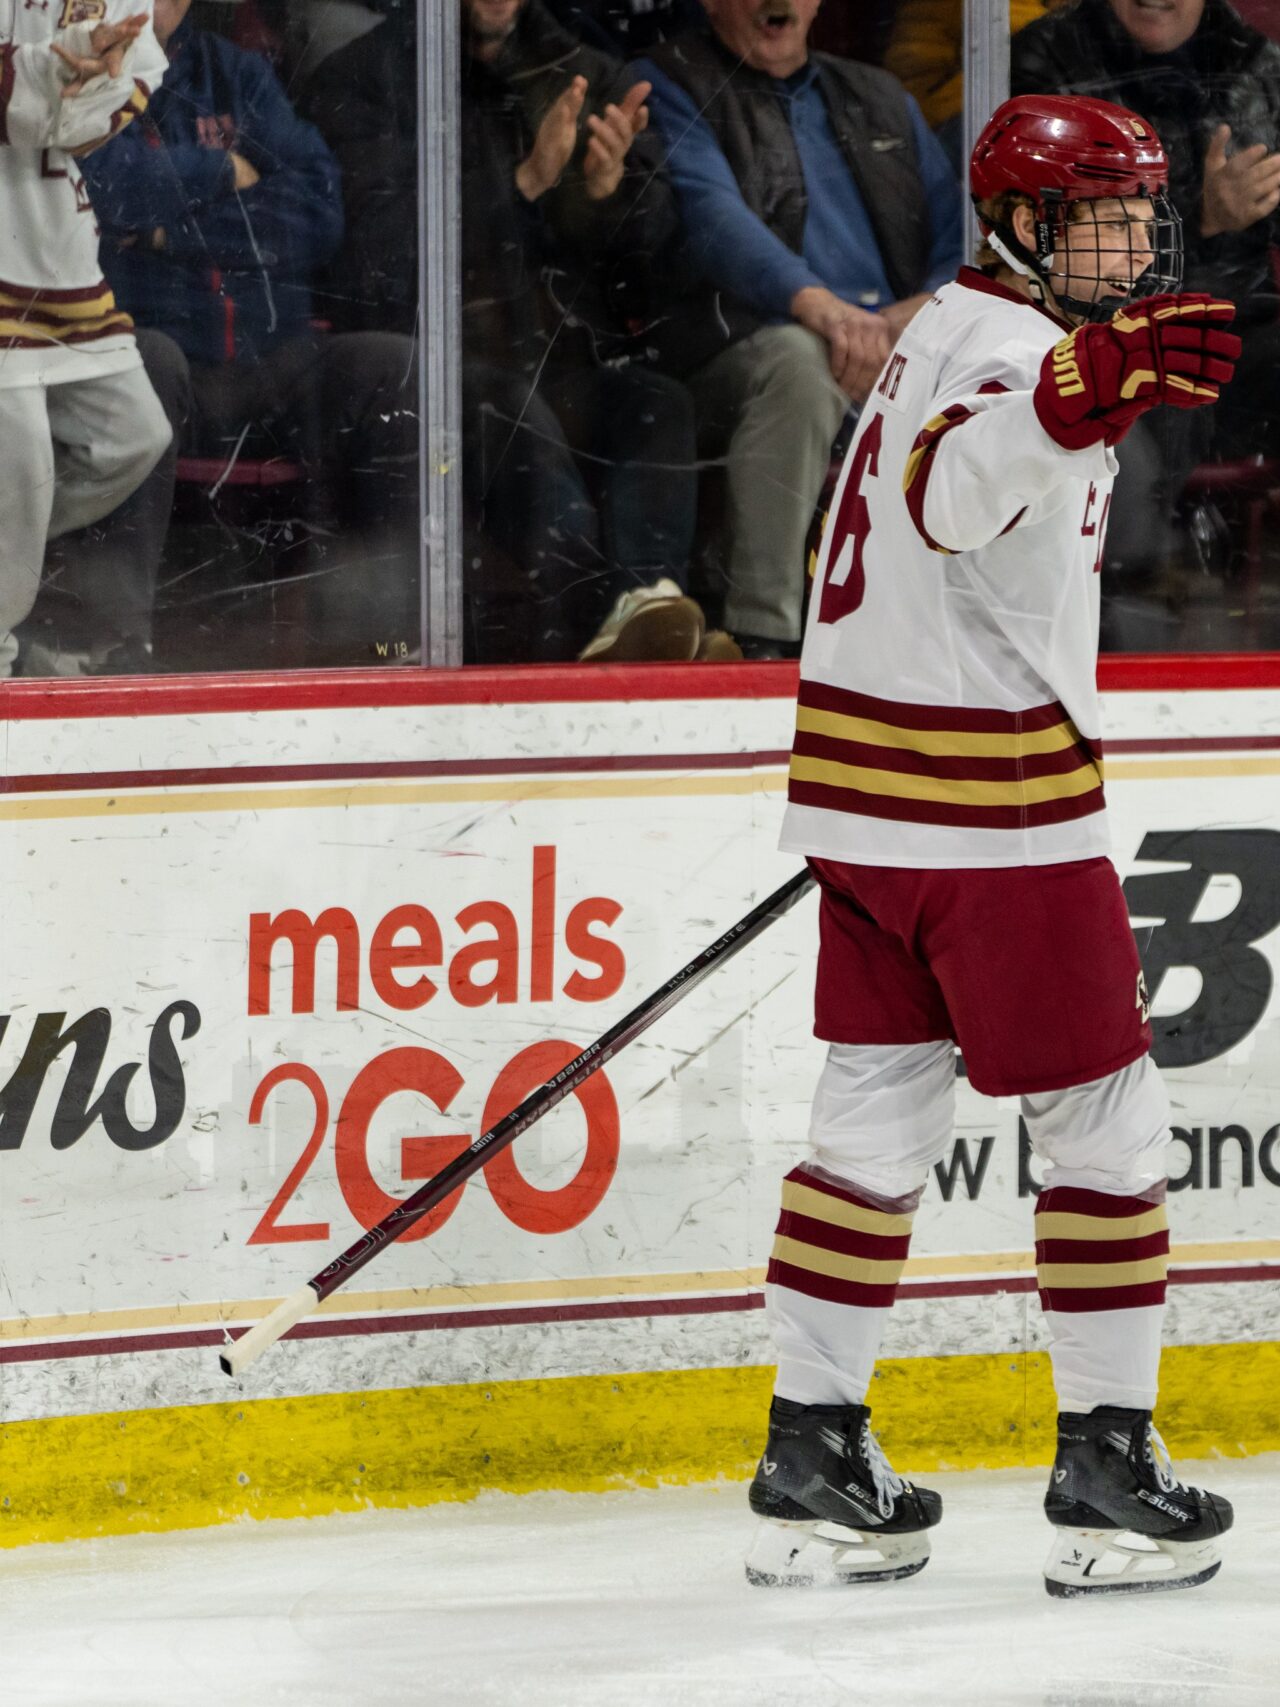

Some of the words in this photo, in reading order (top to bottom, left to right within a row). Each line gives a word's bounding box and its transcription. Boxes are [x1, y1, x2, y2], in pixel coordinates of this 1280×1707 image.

[818, 412, 884, 625] 6
[375, 641, 389, 657] W
[394, 641, 409, 658] 18
[248, 845, 627, 1016] meals
[246, 1040, 620, 1246] 2GO
[470, 1132, 496, 1153] SMITH
[1137, 1488, 1189, 1523] BAUER
